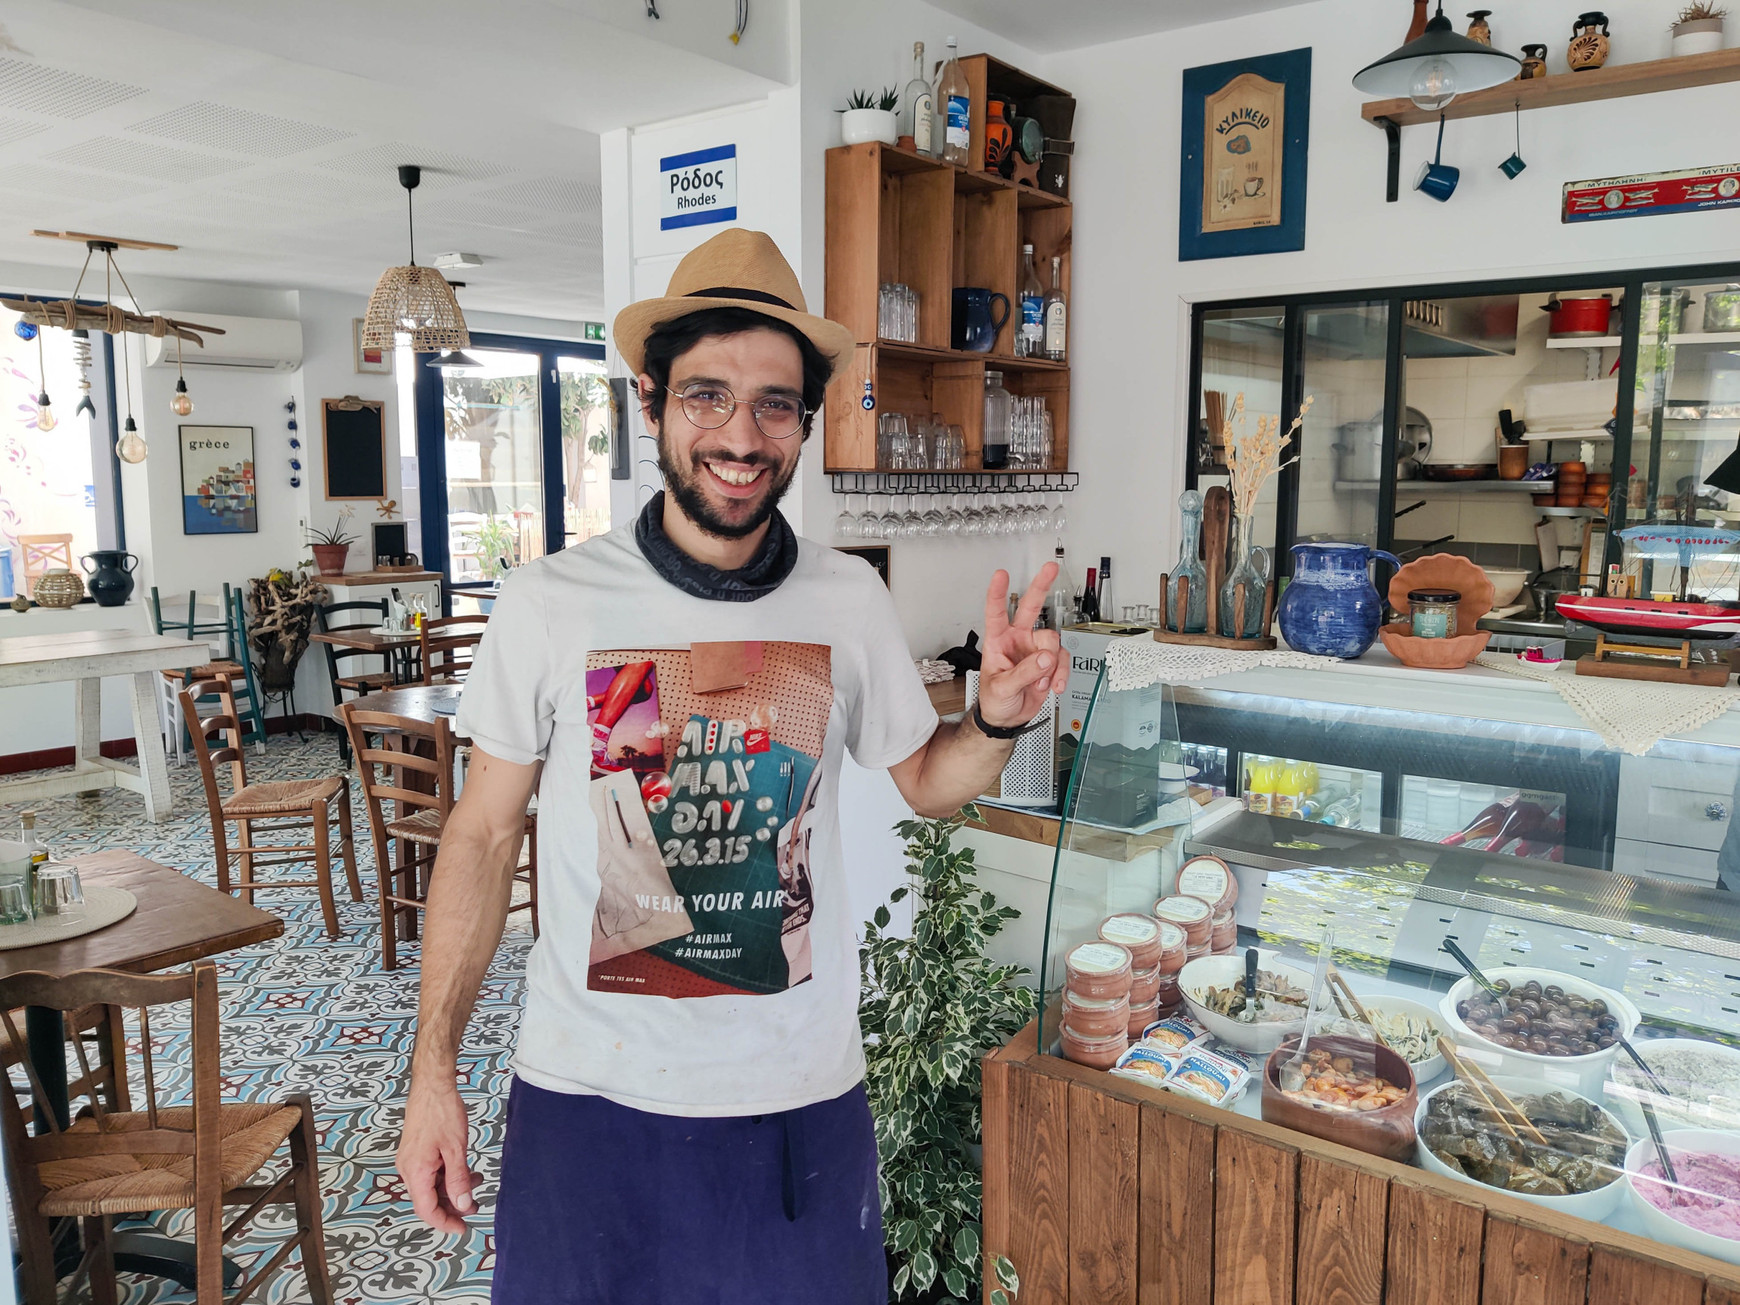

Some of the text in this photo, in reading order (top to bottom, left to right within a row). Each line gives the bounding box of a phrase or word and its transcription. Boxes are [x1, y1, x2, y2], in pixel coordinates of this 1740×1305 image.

[670, 168, 724, 194] Ρόδος
[677, 193, 717, 210] Rhodes
[189, 439, 230, 451] grèce
[677, 719, 746, 758] AIR
[668, 759, 755, 798] MAX
[671, 799, 745, 834] DAY
[662, 835, 753, 867] 26.3.15
[635, 893, 685, 913] WEAR
[692, 891, 744, 912] YOUR
[685, 933, 732, 944] #AIRMAX
[674, 948, 743, 960] #AIRMAXDAY
[1190, 1057, 1226, 1081] HALLOUMI
